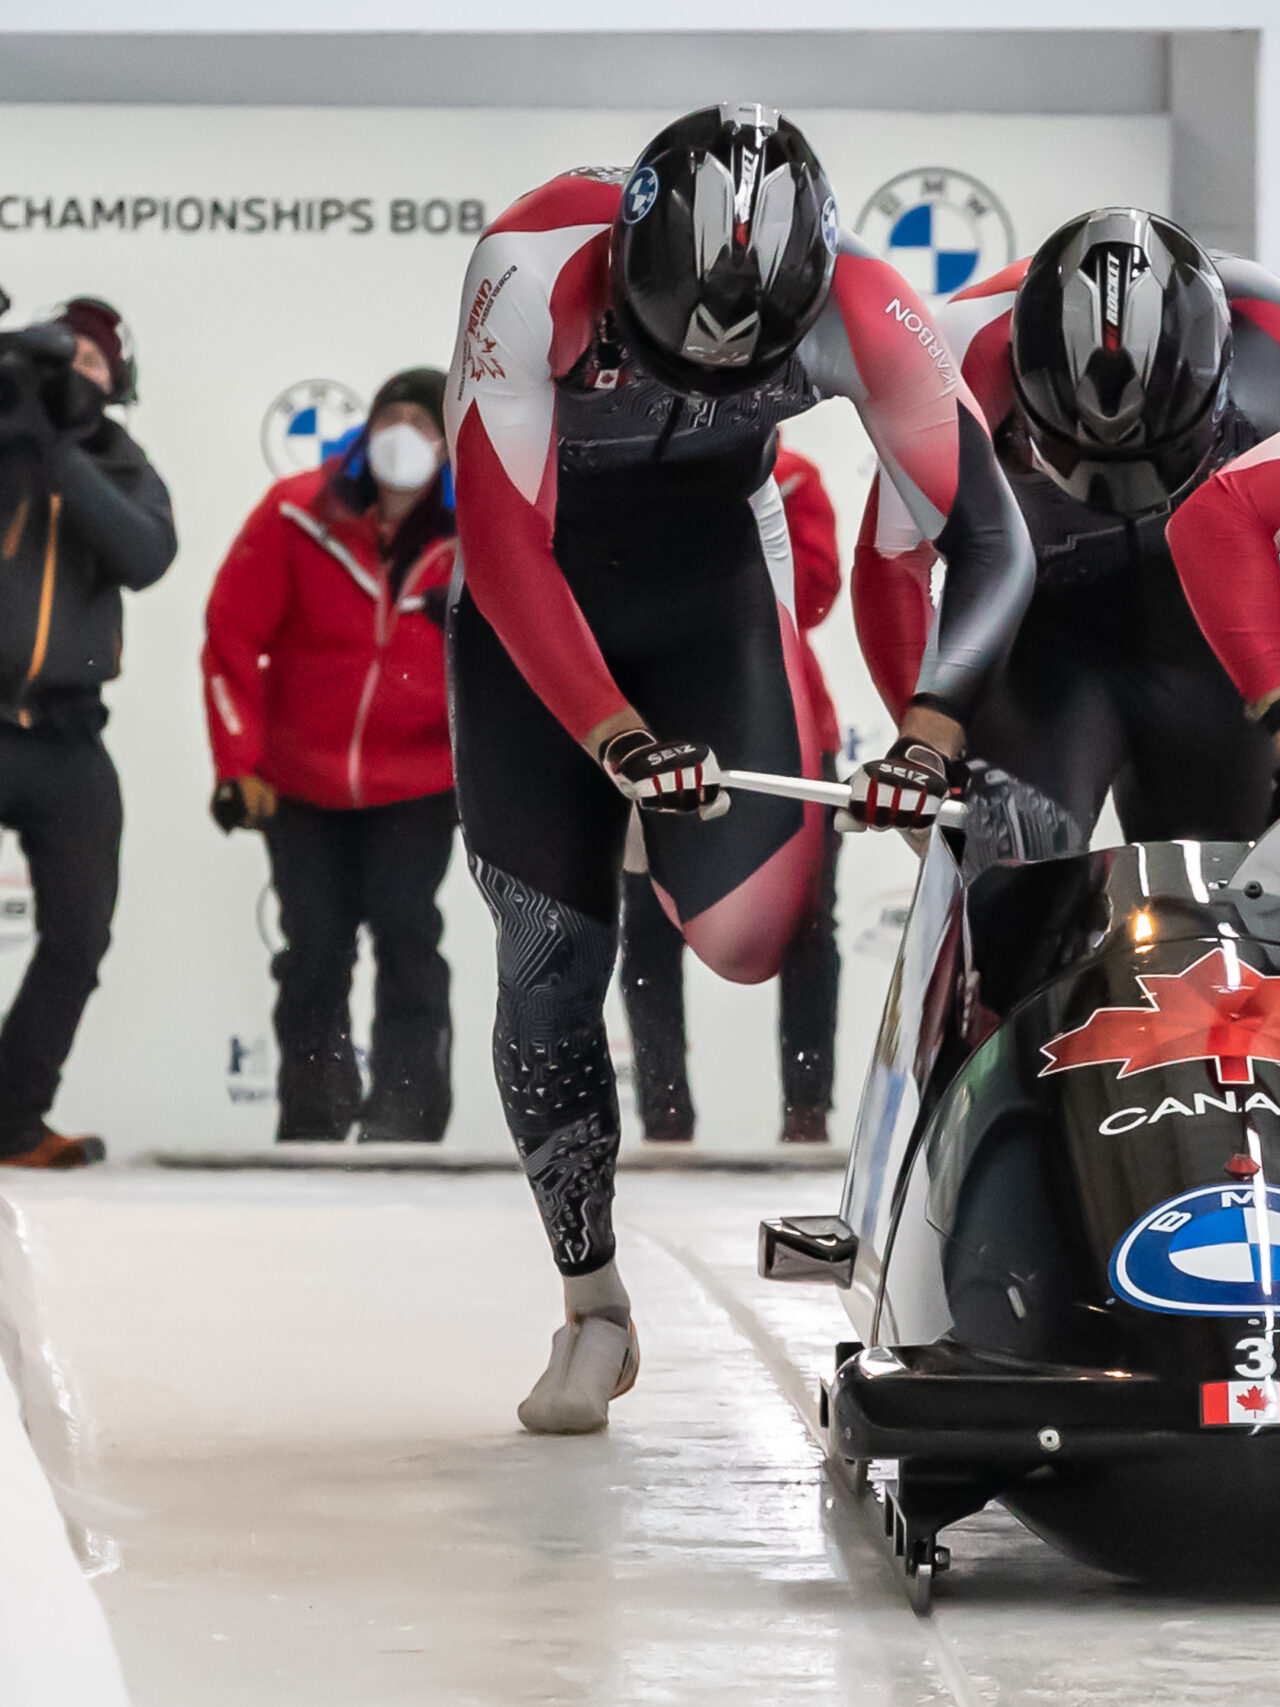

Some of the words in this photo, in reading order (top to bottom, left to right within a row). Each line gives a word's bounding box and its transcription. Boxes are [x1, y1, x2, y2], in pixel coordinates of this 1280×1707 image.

[0, 198, 374, 233] CHAMPIONSHIPS
[390, 198, 485, 233] BOB
[885, 298, 957, 386] KARBON
[647, 744, 696, 766] SEIZ
[879, 763, 930, 785] SEIZ
[1234, 1337, 1277, 1378] 3
